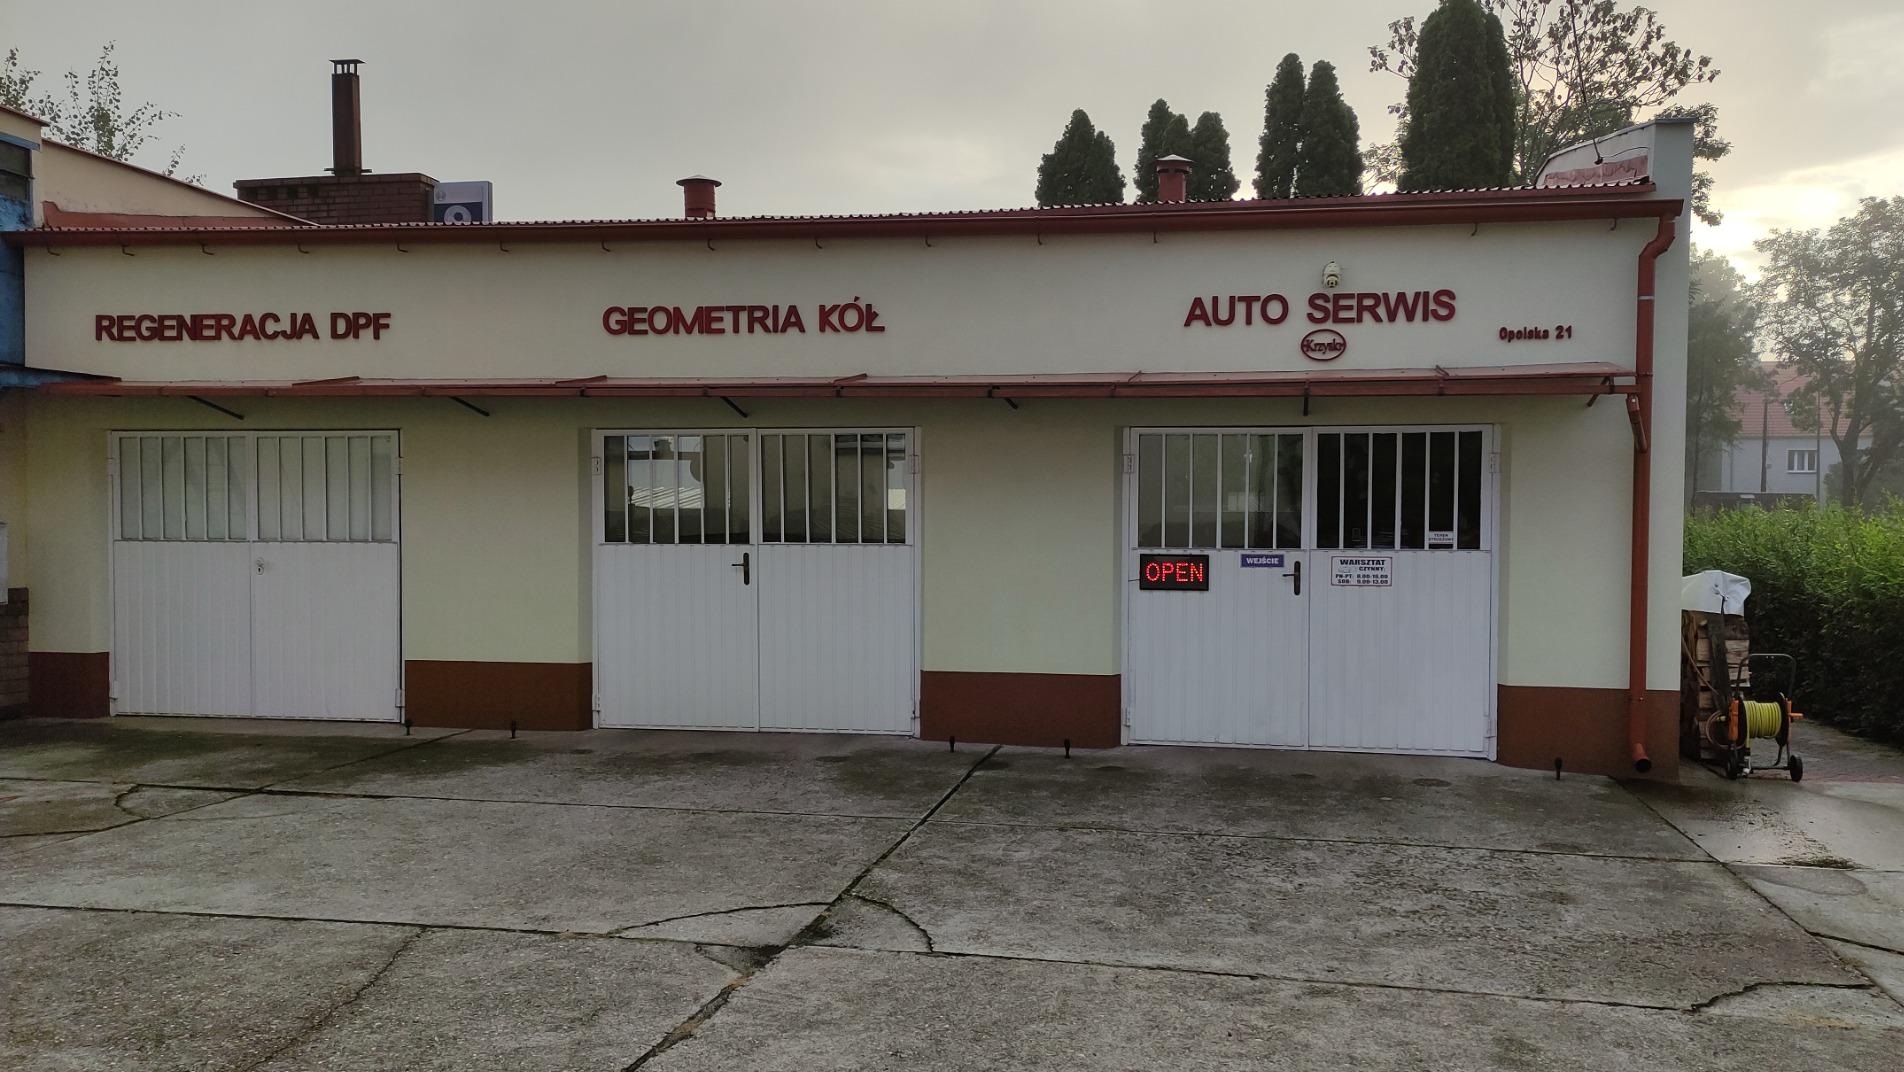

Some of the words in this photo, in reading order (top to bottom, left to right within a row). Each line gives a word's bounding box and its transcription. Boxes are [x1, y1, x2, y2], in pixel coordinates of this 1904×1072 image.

[602, 304, 805, 335] GEOMETRIA
[819, 296, 885, 333] KÓŁ
[1183, 294, 1290, 327] AUTO
[1306, 289, 1457, 324] SERWIS
[95, 312, 320, 342] REGENERACJA
[330, 312, 391, 340] DPF
[1499, 326, 1549, 343] Opolska
[1555, 325, 1573, 340] 21
[1145, 562, 1204, 583] OPEN
[1246, 556, 1279, 564] WEJŚCIE
